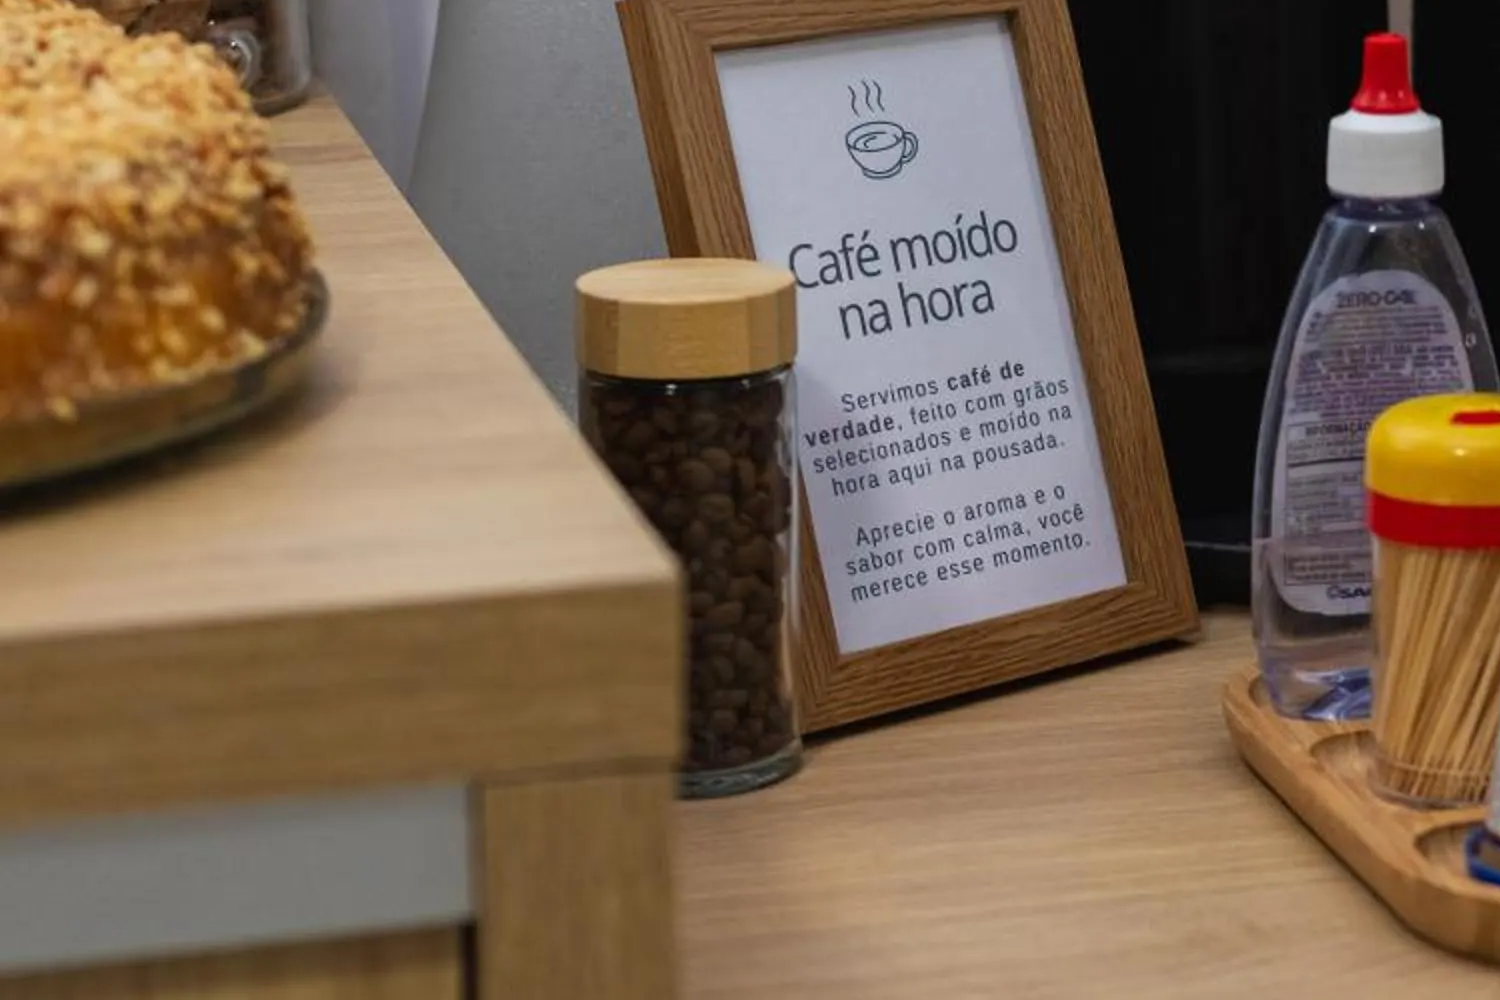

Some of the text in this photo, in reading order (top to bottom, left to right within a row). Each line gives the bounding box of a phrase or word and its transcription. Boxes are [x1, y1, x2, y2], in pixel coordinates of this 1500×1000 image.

[788, 210, 1018, 289] Café moído
[838, 279, 995, 340] na hora
[804, 378, 1070, 449] verdade, feito com grãos
[841, 359, 1026, 414] Servimos café de
[813, 403, 1073, 475] selecionados e moído na
[831, 431, 1066, 497] hora aqui na pousada.
[845, 503, 1085, 576] sabor com calma, você
[855, 485, 1066, 548] Aprecie o aroma e o
[850, 531, 1091, 603] merece esse momento.
